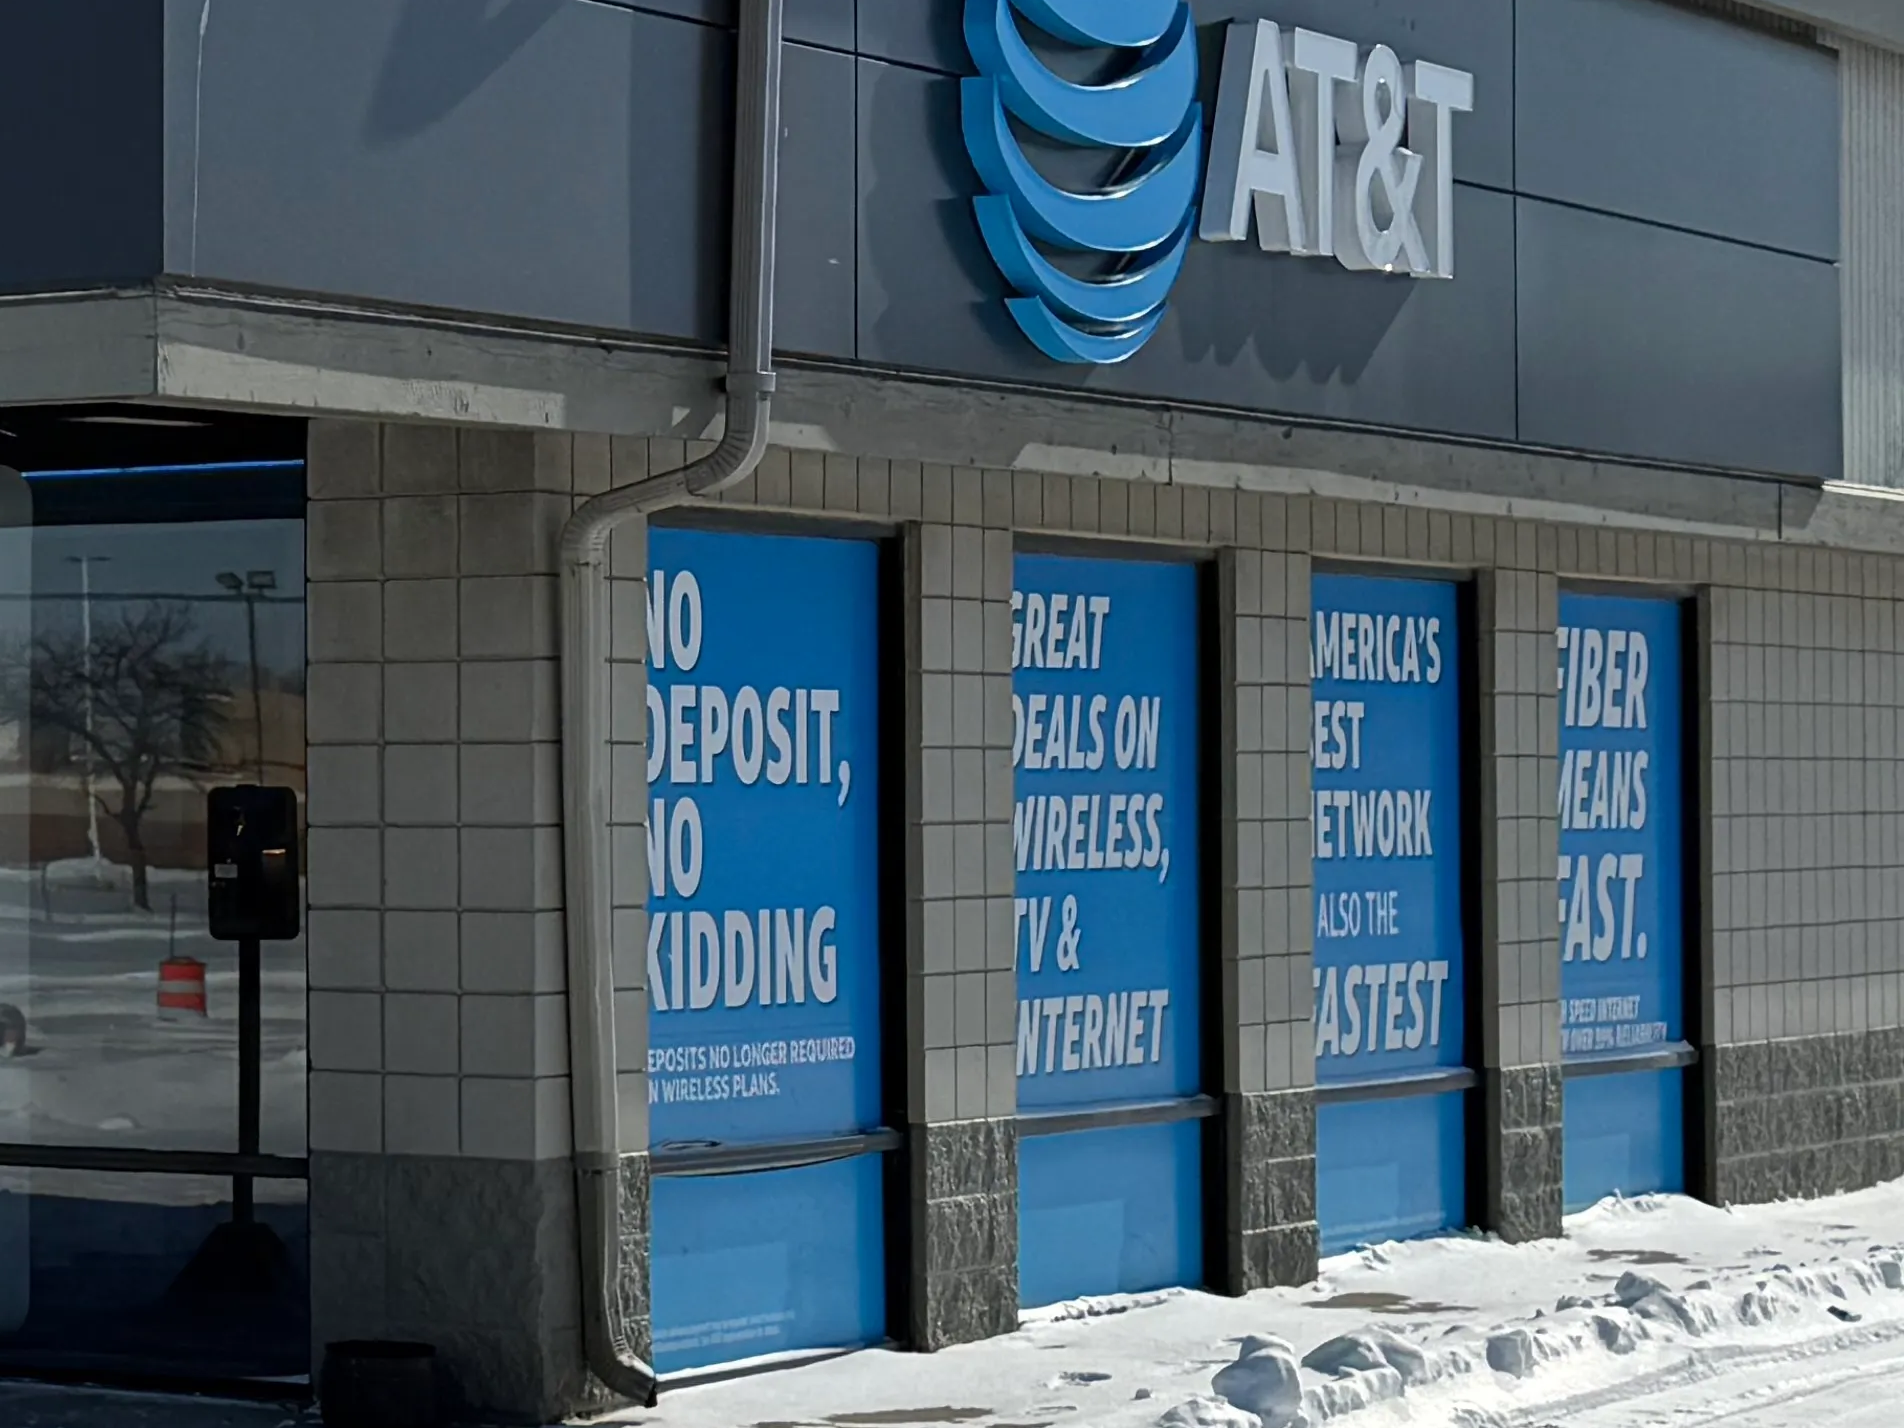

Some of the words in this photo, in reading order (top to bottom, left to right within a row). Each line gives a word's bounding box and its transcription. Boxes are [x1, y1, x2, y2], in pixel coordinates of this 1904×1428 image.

[1200, 18, 1473, 279] AT&T
[646, 569, 702, 671] NO
[646, 683, 851, 807] DEPOSIT,
[1012, 693, 1107, 770] DEALS
[1114, 694, 1161, 770] ON
[1309, 700, 1364, 769] EST
[646, 796, 703, 898] NO
[1311, 789, 1433, 858] ETWORK
[1012, 896, 1052, 973] TV
[1056, 893, 1081, 972] &
[1317, 891, 1361, 938] ALSO
[1364, 890, 1400, 936] THE
[646, 905, 837, 1011] KIDDING
[1015, 988, 1169, 1076] NTERNET
[1313, 960, 1448, 1057] ASTEST
[1569, 998, 1596, 1025] SPEED
[647, 1046, 706, 1073] EPOSITS
[709, 1044, 731, 1070] NO
[733, 1041, 787, 1069] LONGER
[790, 1036, 856, 1065] REQUIRED
[647, 1078, 658, 1105] N
[661, 1075, 730, 1104] WIRELESS
[732, 1072, 781, 1098] PLANS.
